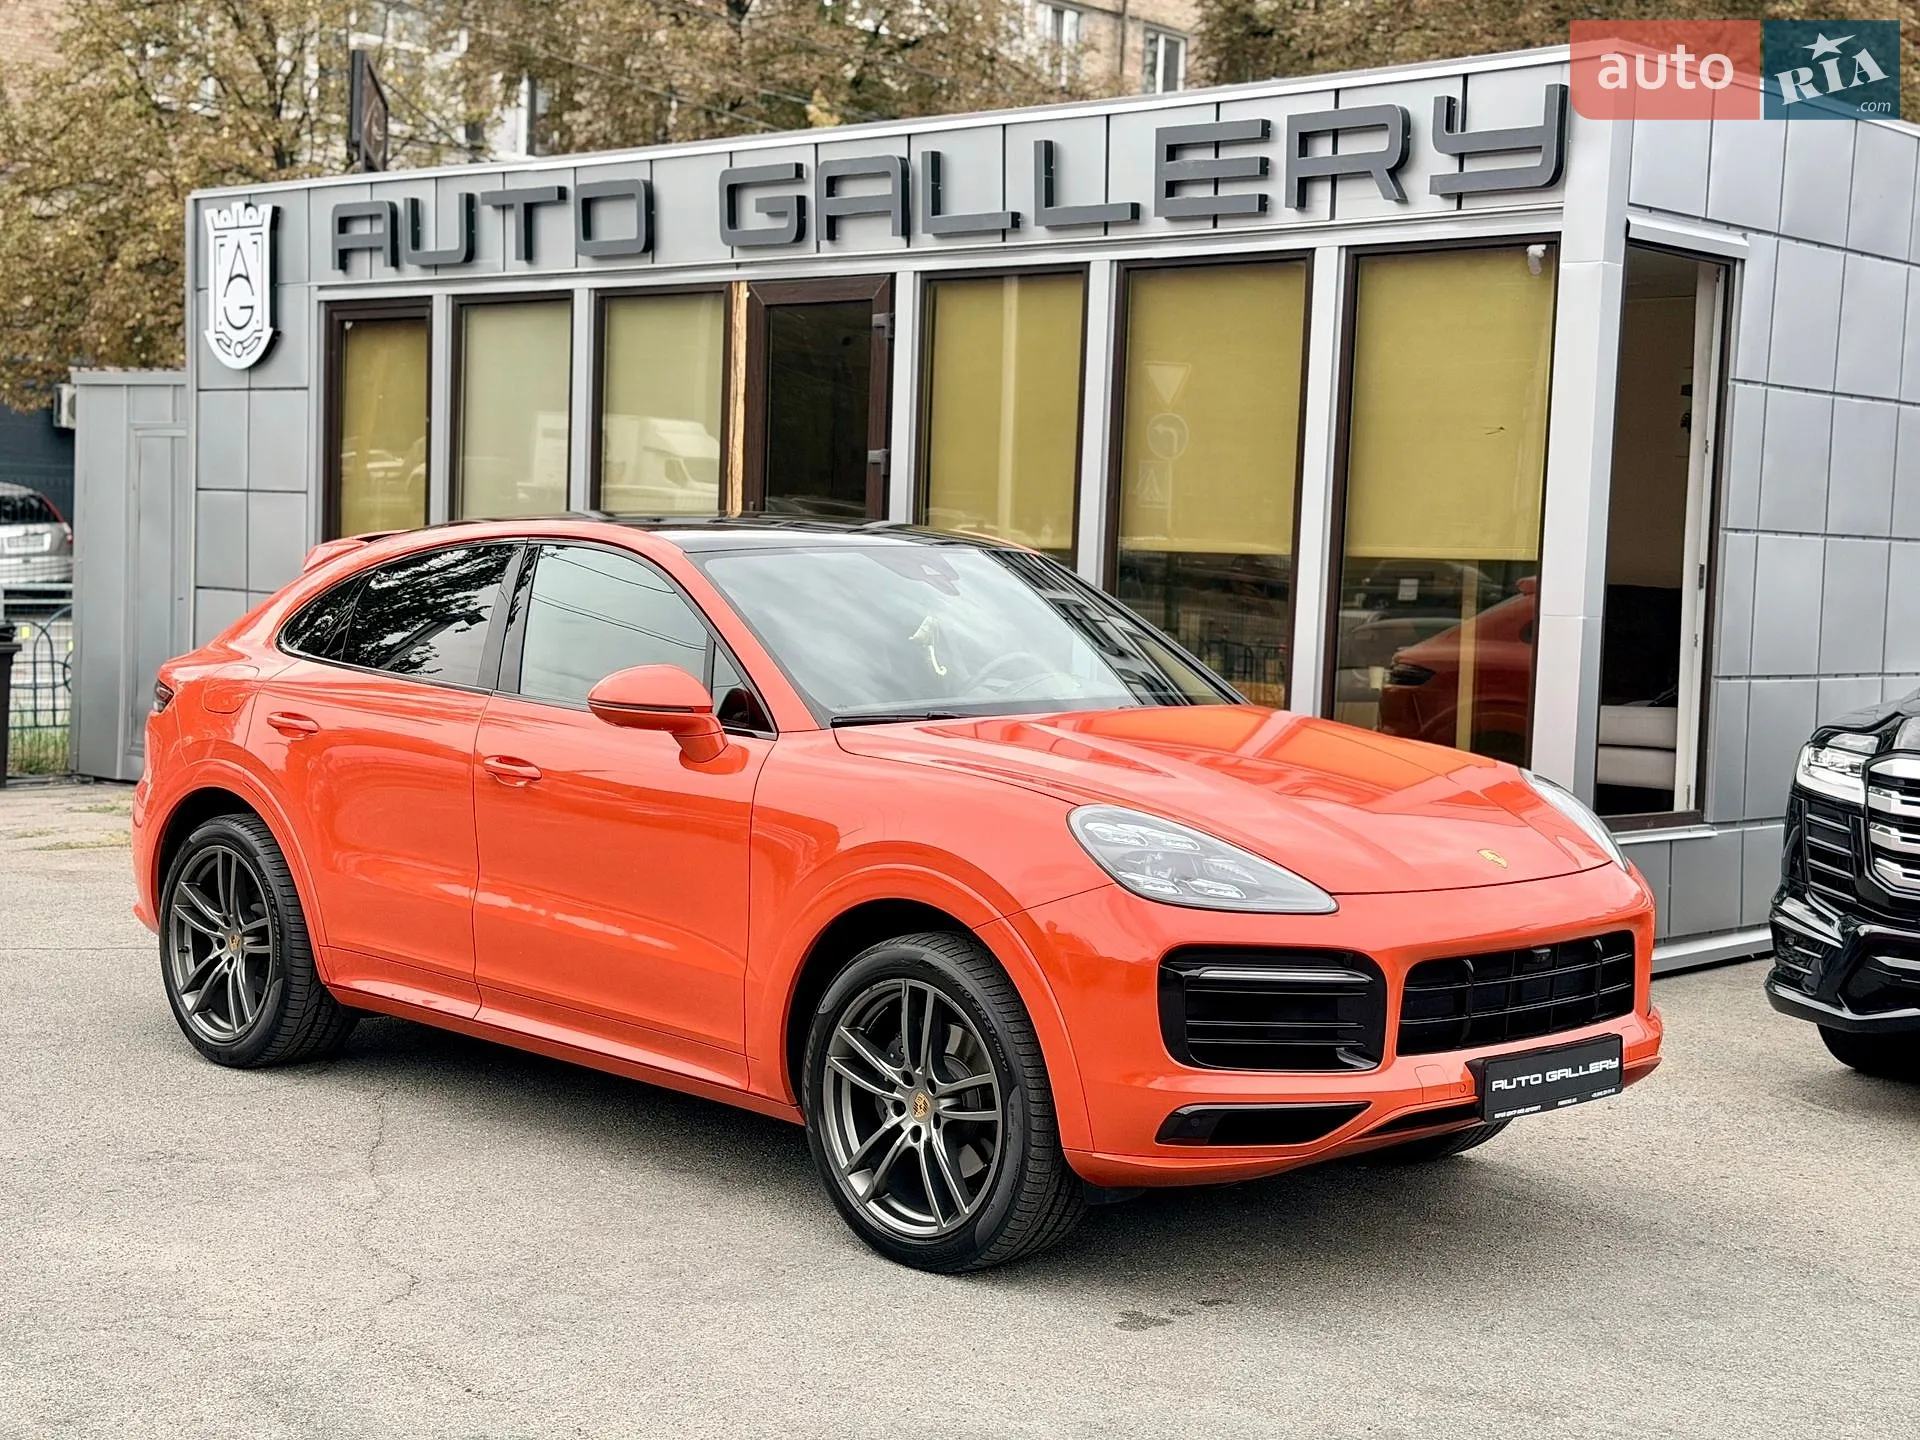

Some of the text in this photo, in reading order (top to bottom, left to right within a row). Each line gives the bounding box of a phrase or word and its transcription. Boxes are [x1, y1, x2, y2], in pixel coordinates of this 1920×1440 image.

[331, 84, 1567, 273] AUTO GALLERY
[1492, 1057, 1619, 1091] AUTO GALLERY
